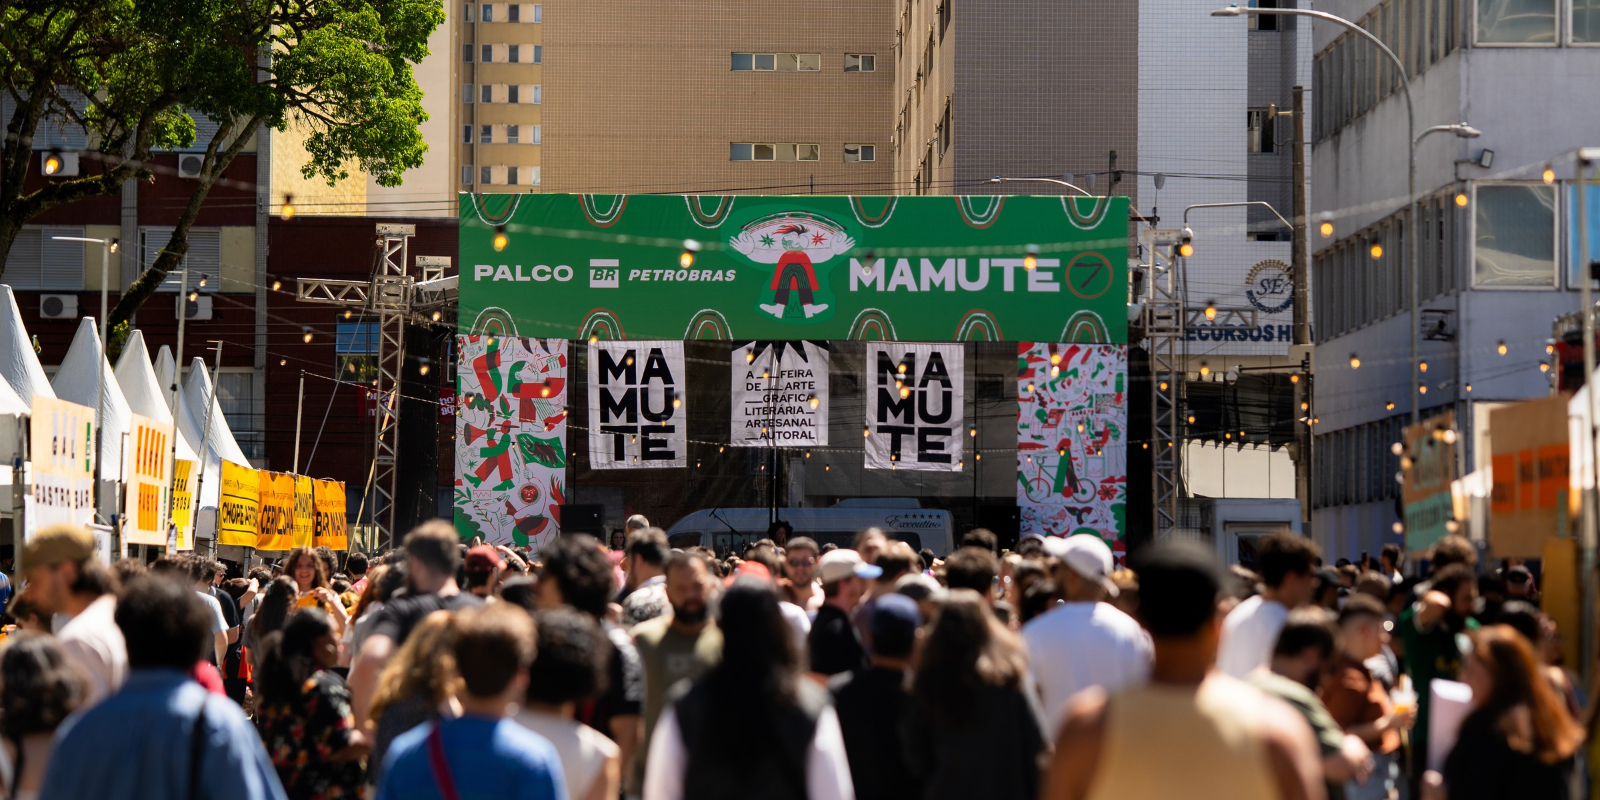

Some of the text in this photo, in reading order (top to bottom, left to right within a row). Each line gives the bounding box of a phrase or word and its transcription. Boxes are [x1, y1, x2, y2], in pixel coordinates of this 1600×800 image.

[474, 265, 574, 282] PALCO
[628, 269, 736, 282] PETROBRAS
[849, 257, 1061, 292] MAMUTE
[1175, 323, 1275, 342] ECURSOS
[599, 348, 674, 386] MA
[745, 369, 814, 379] A FEIRA
[876, 350, 953, 389] MA
[745, 381, 816, 392] DE ARTE
[599, 387, 675, 424] MU
[745, 404, 805, 416] LITERÁRIA
[876, 389, 953, 425] MU
[745, 418, 815, 428] ARTESANAL
[599, 425, 675, 462] TE
[759, 430, 815, 440] AUTORAL
[876, 425, 953, 464] TE
[222, 501, 244, 525] CHOPE
[885, 514, 941, 530] Executivo
